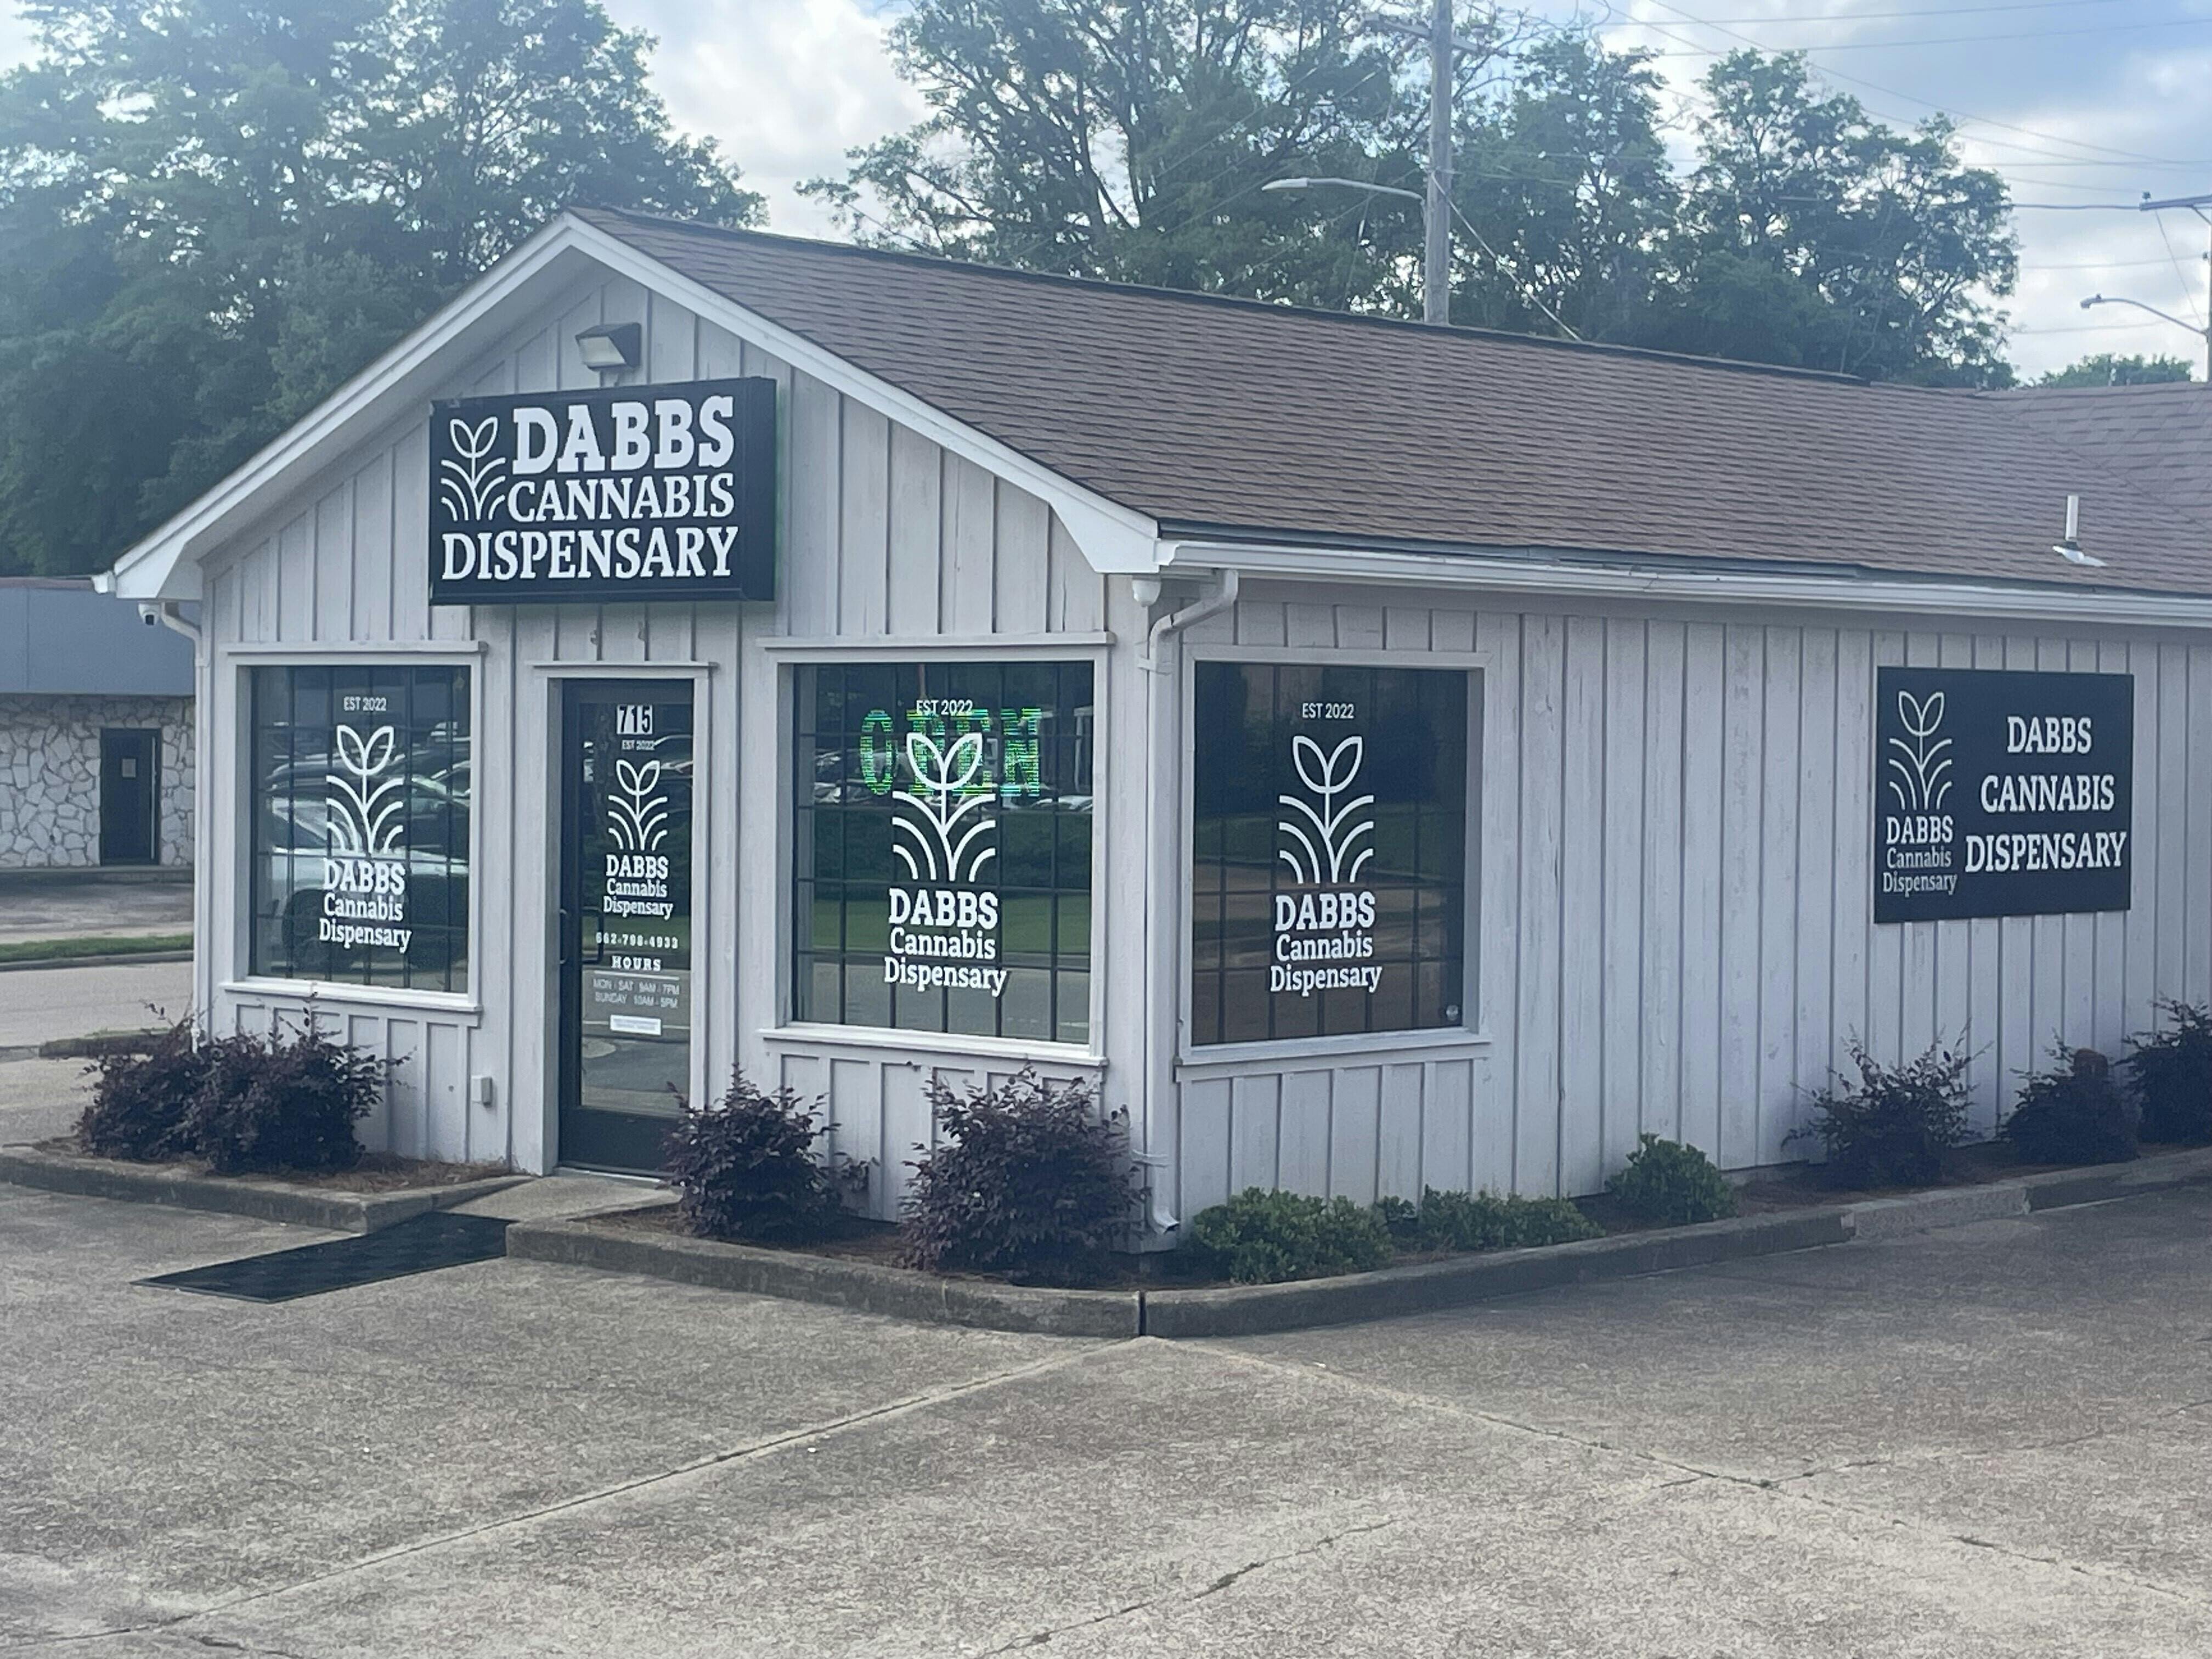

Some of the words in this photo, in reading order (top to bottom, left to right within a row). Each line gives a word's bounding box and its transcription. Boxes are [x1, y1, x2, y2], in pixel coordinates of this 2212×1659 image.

[512, 395, 735, 475] DABBS
[507, 472, 736, 523] CANNABIS
[442, 526, 738, 581] DISPENSARY
[343, 697, 360, 711] EST
[363, 697, 387, 712] 2022
[619, 706, 651, 733] 715
[916, 700, 939, 715] EST
[941, 700, 973, 715] 2022
[1302, 703, 1323, 719] EST
[1325, 703, 1354, 719] 2022
[2007, 716, 2092, 754] DABBS
[860, 708, 1041, 797] OPEN
[1980, 775, 2115, 813] CANNABIS
[1886, 815, 1953, 844] DABBS
[606, 855, 669, 879] DABBS
[1887, 845, 1952, 868] Cannabis
[1965, 832, 2127, 873] DISPENSARY
[323, 857, 405, 895] DABBS
[607, 879, 668, 898] Cannabis
[1883, 871, 1957, 898] Dispensary
[324, 893, 404, 922] Cannabis
[603, 896, 674, 921] Dispensary
[889, 888, 998, 929] DABBS
[1275, 891, 1375, 932] DABBS
[319, 918, 412, 953] Dispensary
[890, 927, 996, 959] Cannabis
[1276, 930, 1373, 961] Cannabis
[611, 955, 661, 972] HOURS
[884, 957, 1006, 996] Dispensary
[1271, 965, 1382, 997] Dispensary
